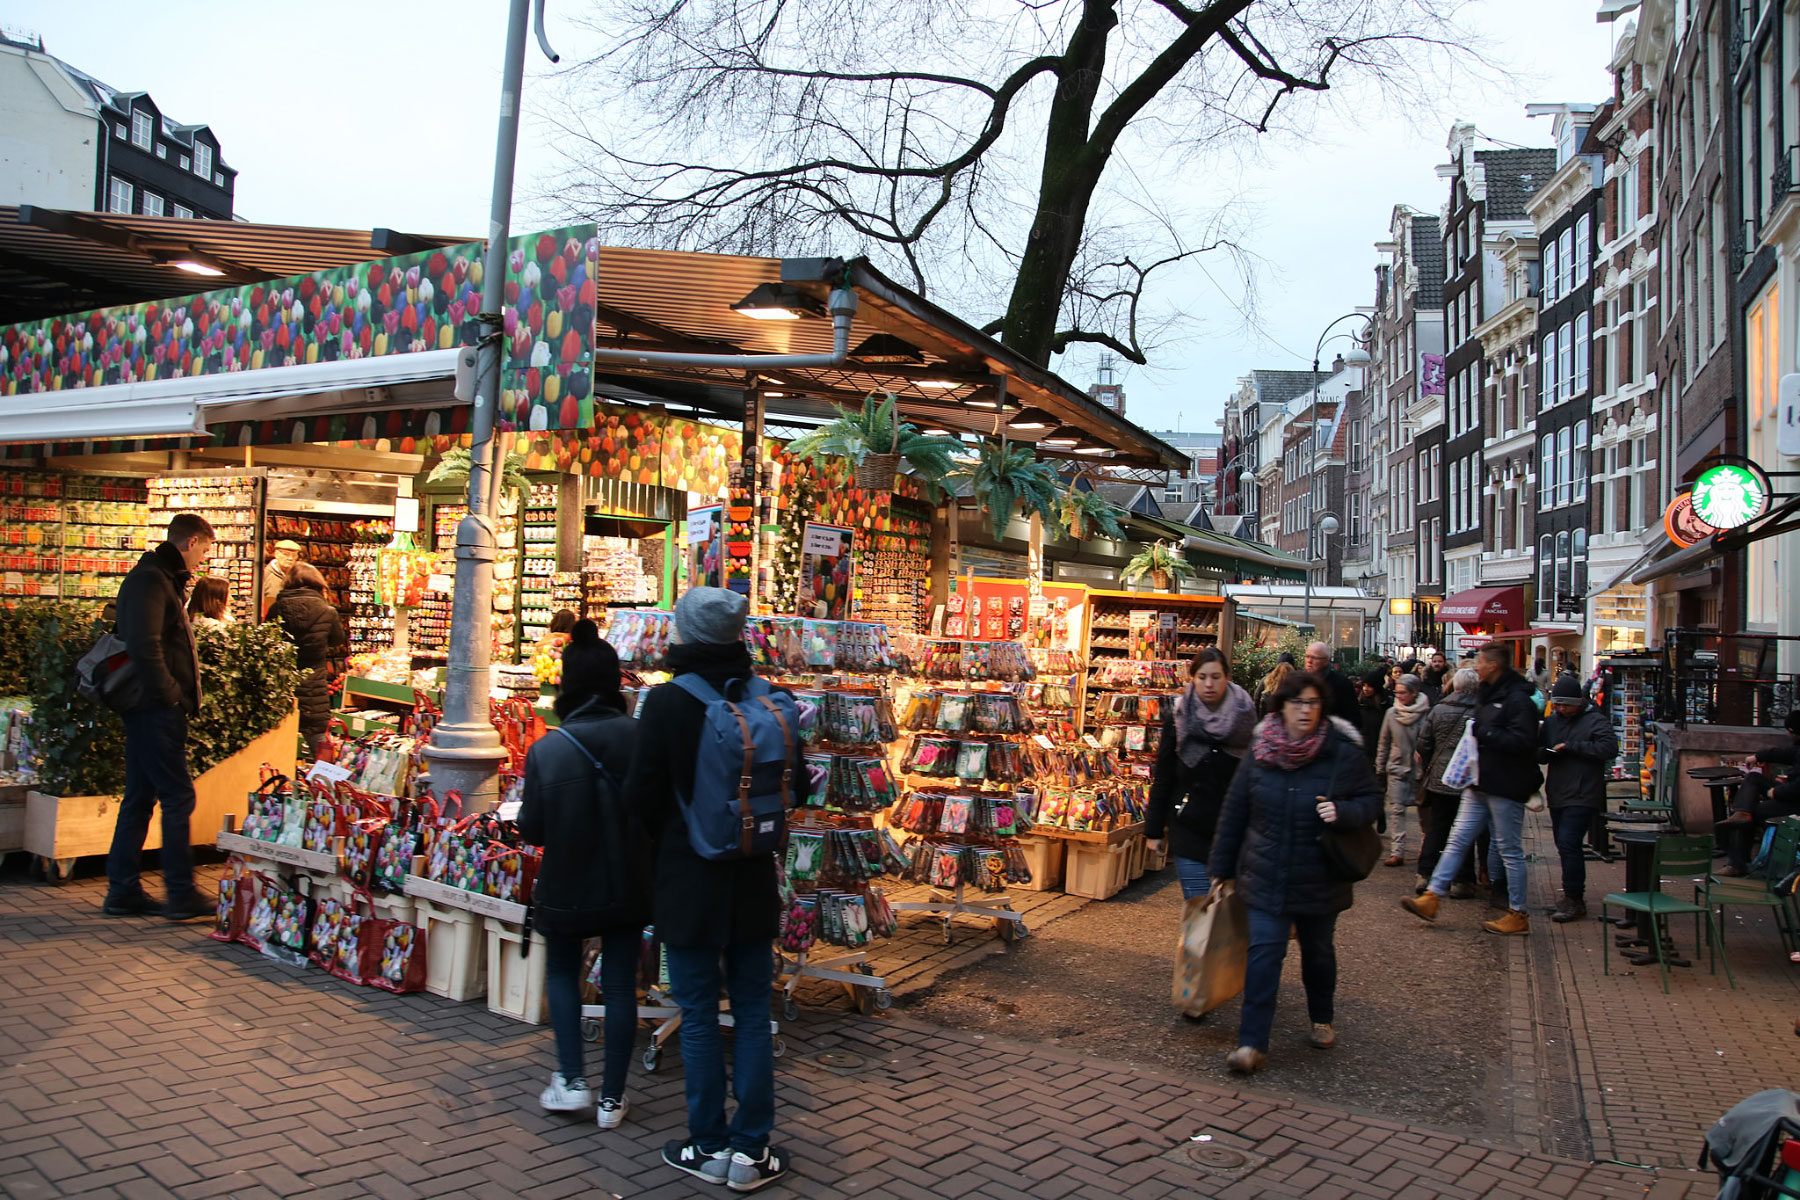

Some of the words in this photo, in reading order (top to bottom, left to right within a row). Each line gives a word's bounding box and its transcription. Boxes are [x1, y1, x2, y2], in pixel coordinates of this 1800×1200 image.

[397, 555, 408, 605] HOLLAND
[680, 1146, 695, 1161] N
[768, 1155, 781, 1172] N
